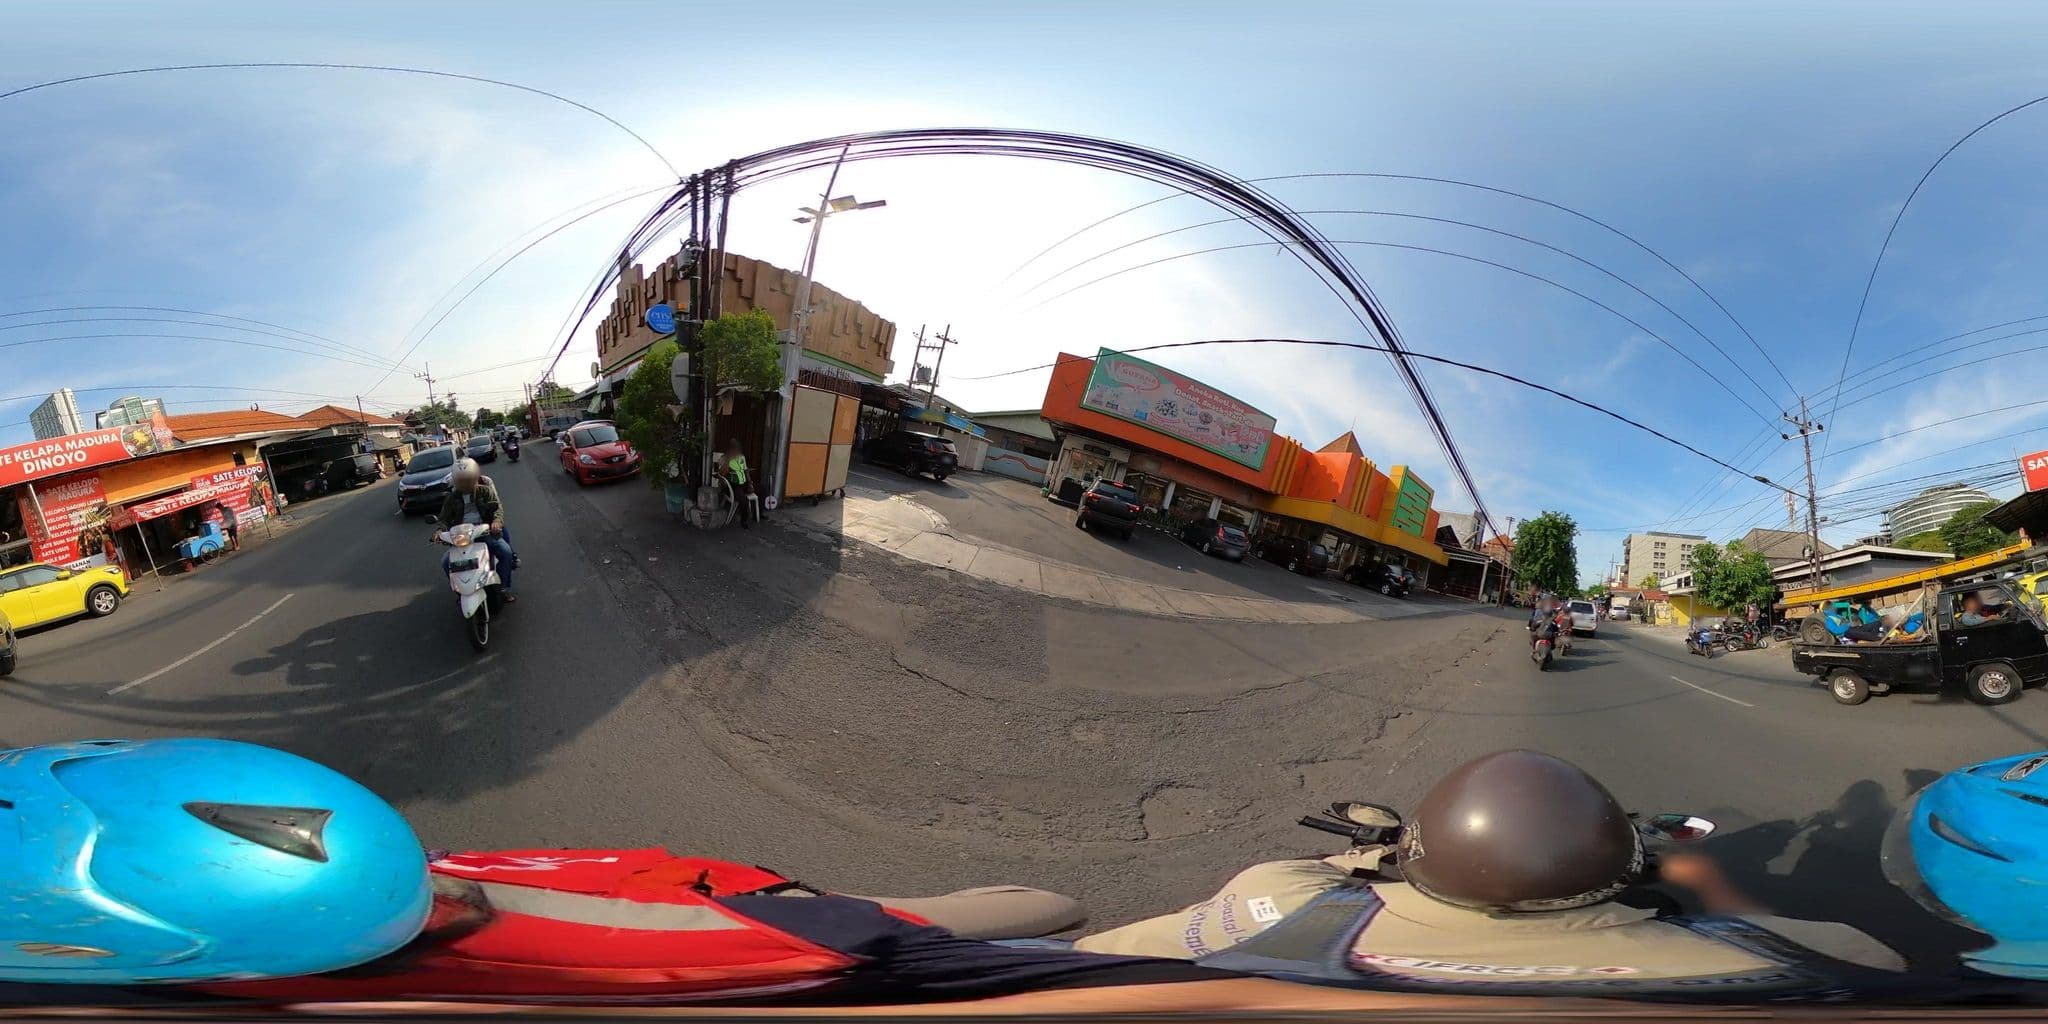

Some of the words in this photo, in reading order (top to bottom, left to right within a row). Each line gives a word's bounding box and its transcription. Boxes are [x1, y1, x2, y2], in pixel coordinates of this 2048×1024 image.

[14, 443, 63, 462] KELAPA
[65, 432, 121, 453] MADURA
[22, 450, 87, 475] DINOYO
[212, 471, 234, 483] SATE
[233, 465, 263, 478] KELOPO
[46, 484, 67, 496] SATE
[66, 477, 99, 492] KELOPO
[58, 486, 95, 502] MADURA
